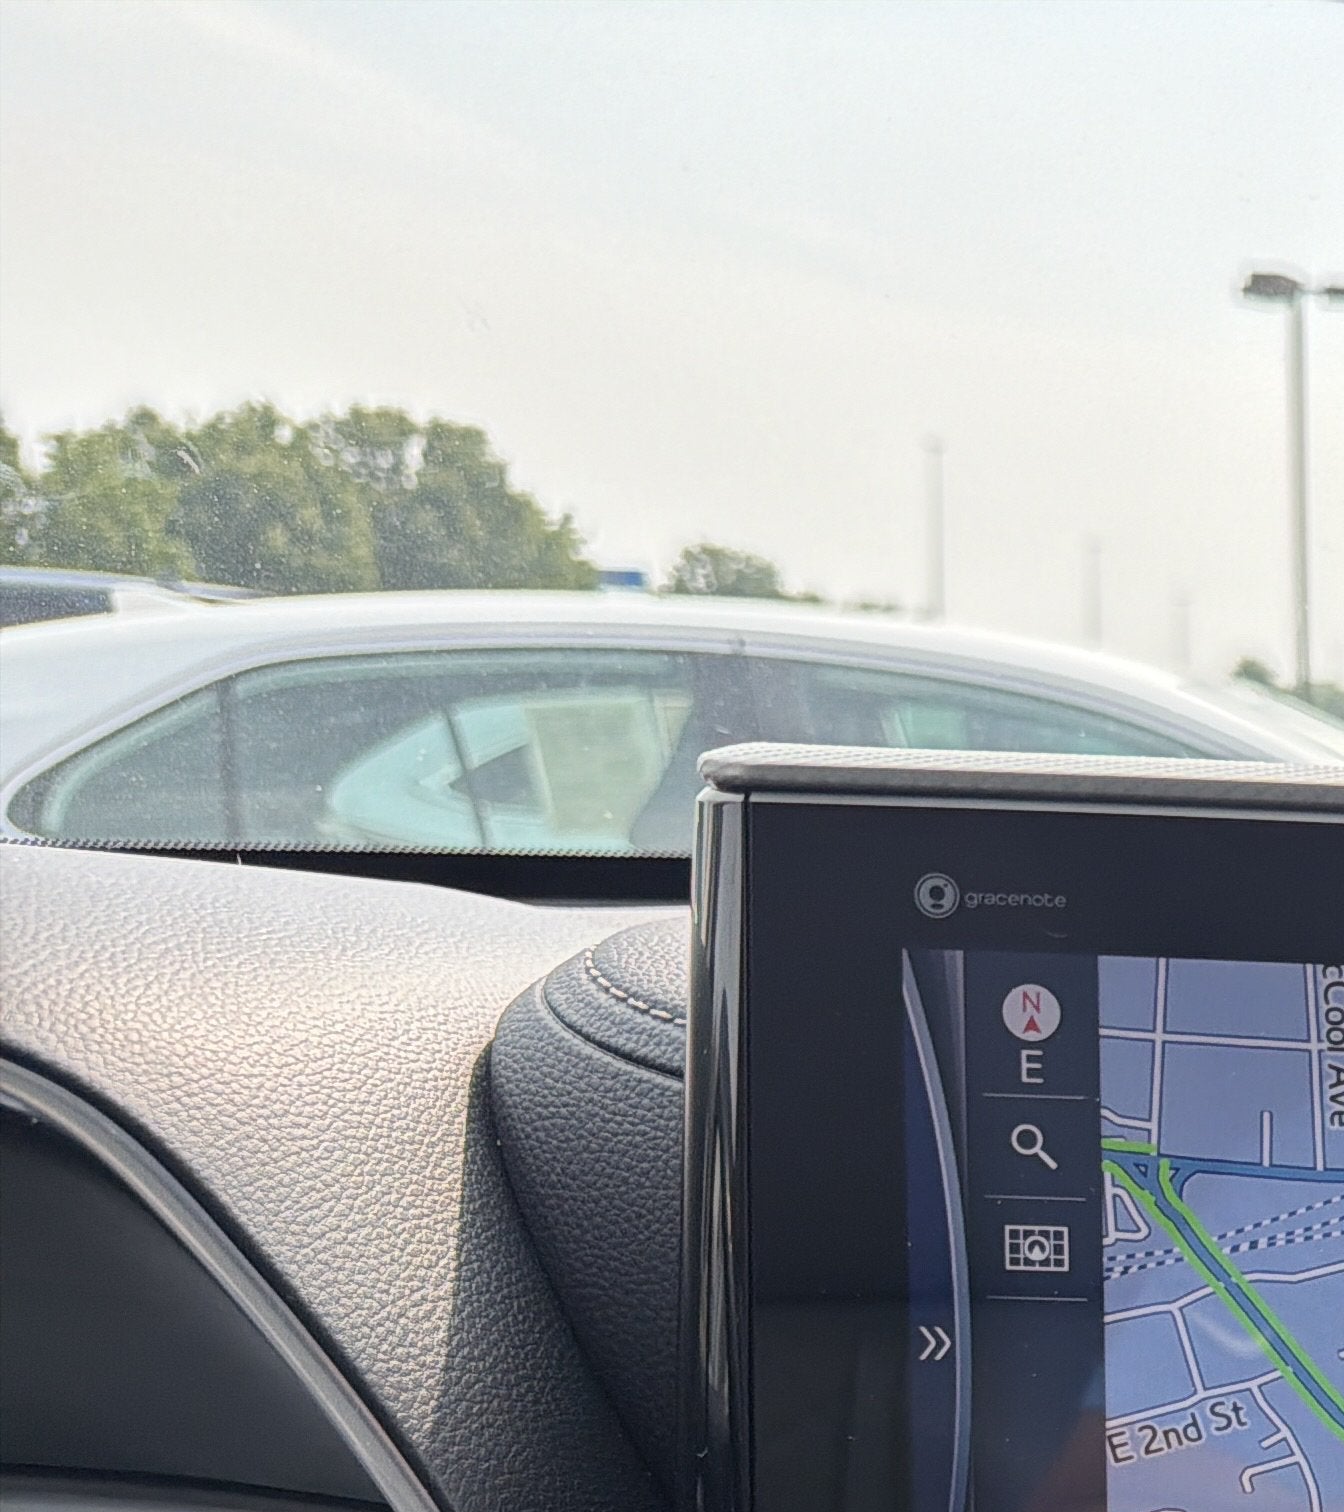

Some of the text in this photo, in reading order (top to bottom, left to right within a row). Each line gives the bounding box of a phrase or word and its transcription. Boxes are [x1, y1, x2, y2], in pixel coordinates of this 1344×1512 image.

[964, 891, 1067, 909] gracenote
[1021, 990, 1042, 1016] N
[1020, 1049, 1045, 1083] E
[1108, 1403, 1247, 1464] E 2nd St
